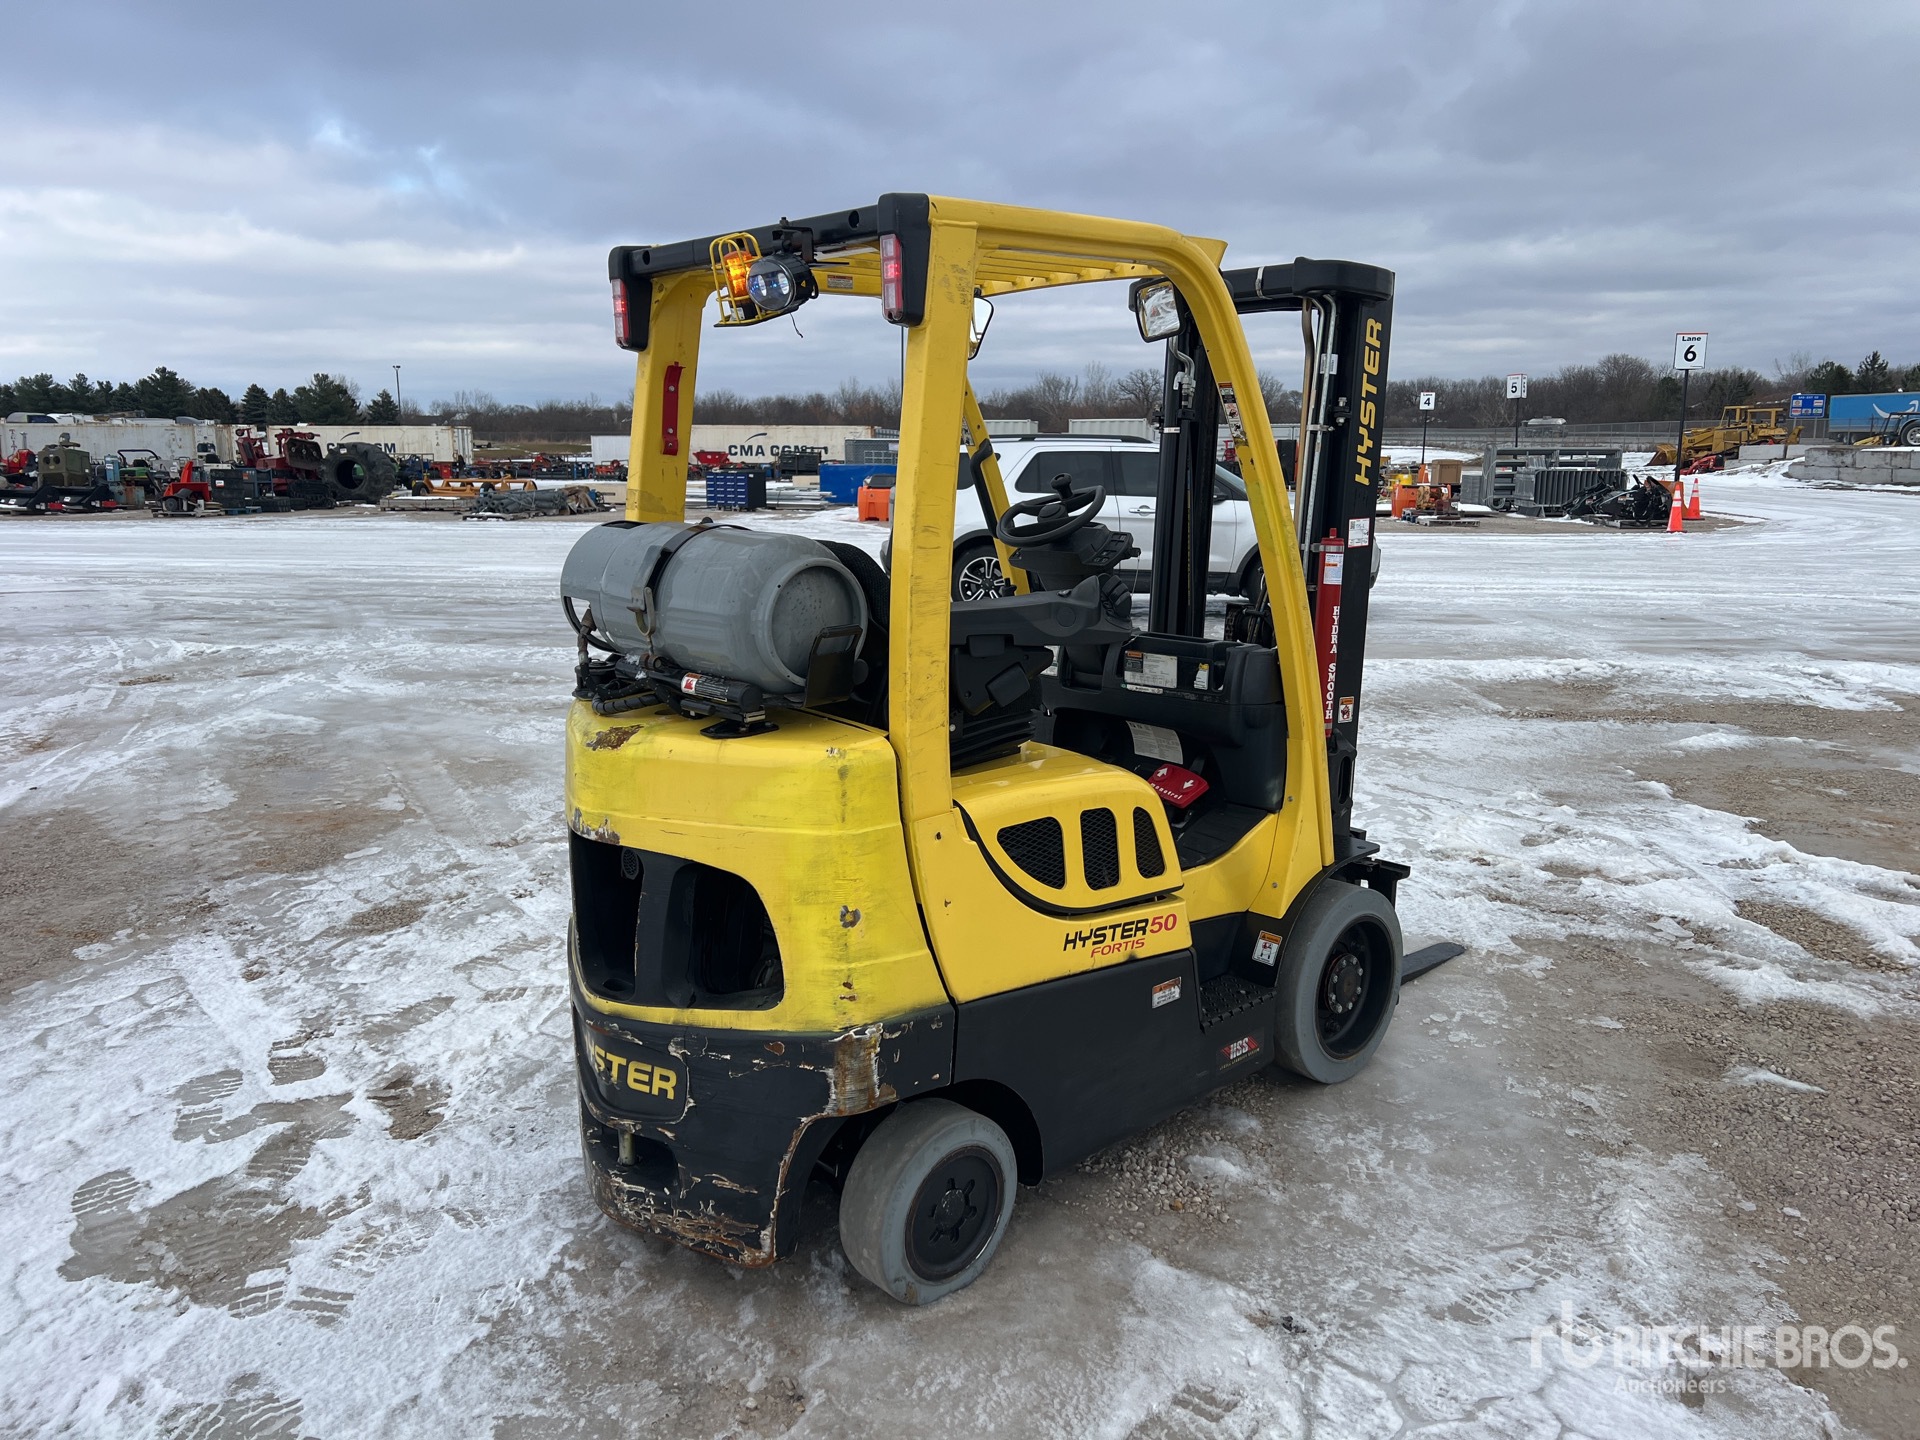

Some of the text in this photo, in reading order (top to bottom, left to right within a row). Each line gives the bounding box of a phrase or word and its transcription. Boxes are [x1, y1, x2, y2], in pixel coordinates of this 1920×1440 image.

[1683, 344, 1697, 363] 6
[1510, 381, 1518, 394] 5
[1354, 317, 1383, 486] HYSTER
[1423, 397, 1431, 407] 4
[728, 444, 765, 457] CMA
[1325, 605, 1341, 720] HYDRA SMOOTH
[1062, 913, 1178, 952] HYSTER 50
[1090, 937, 1146, 958] FORTIS
